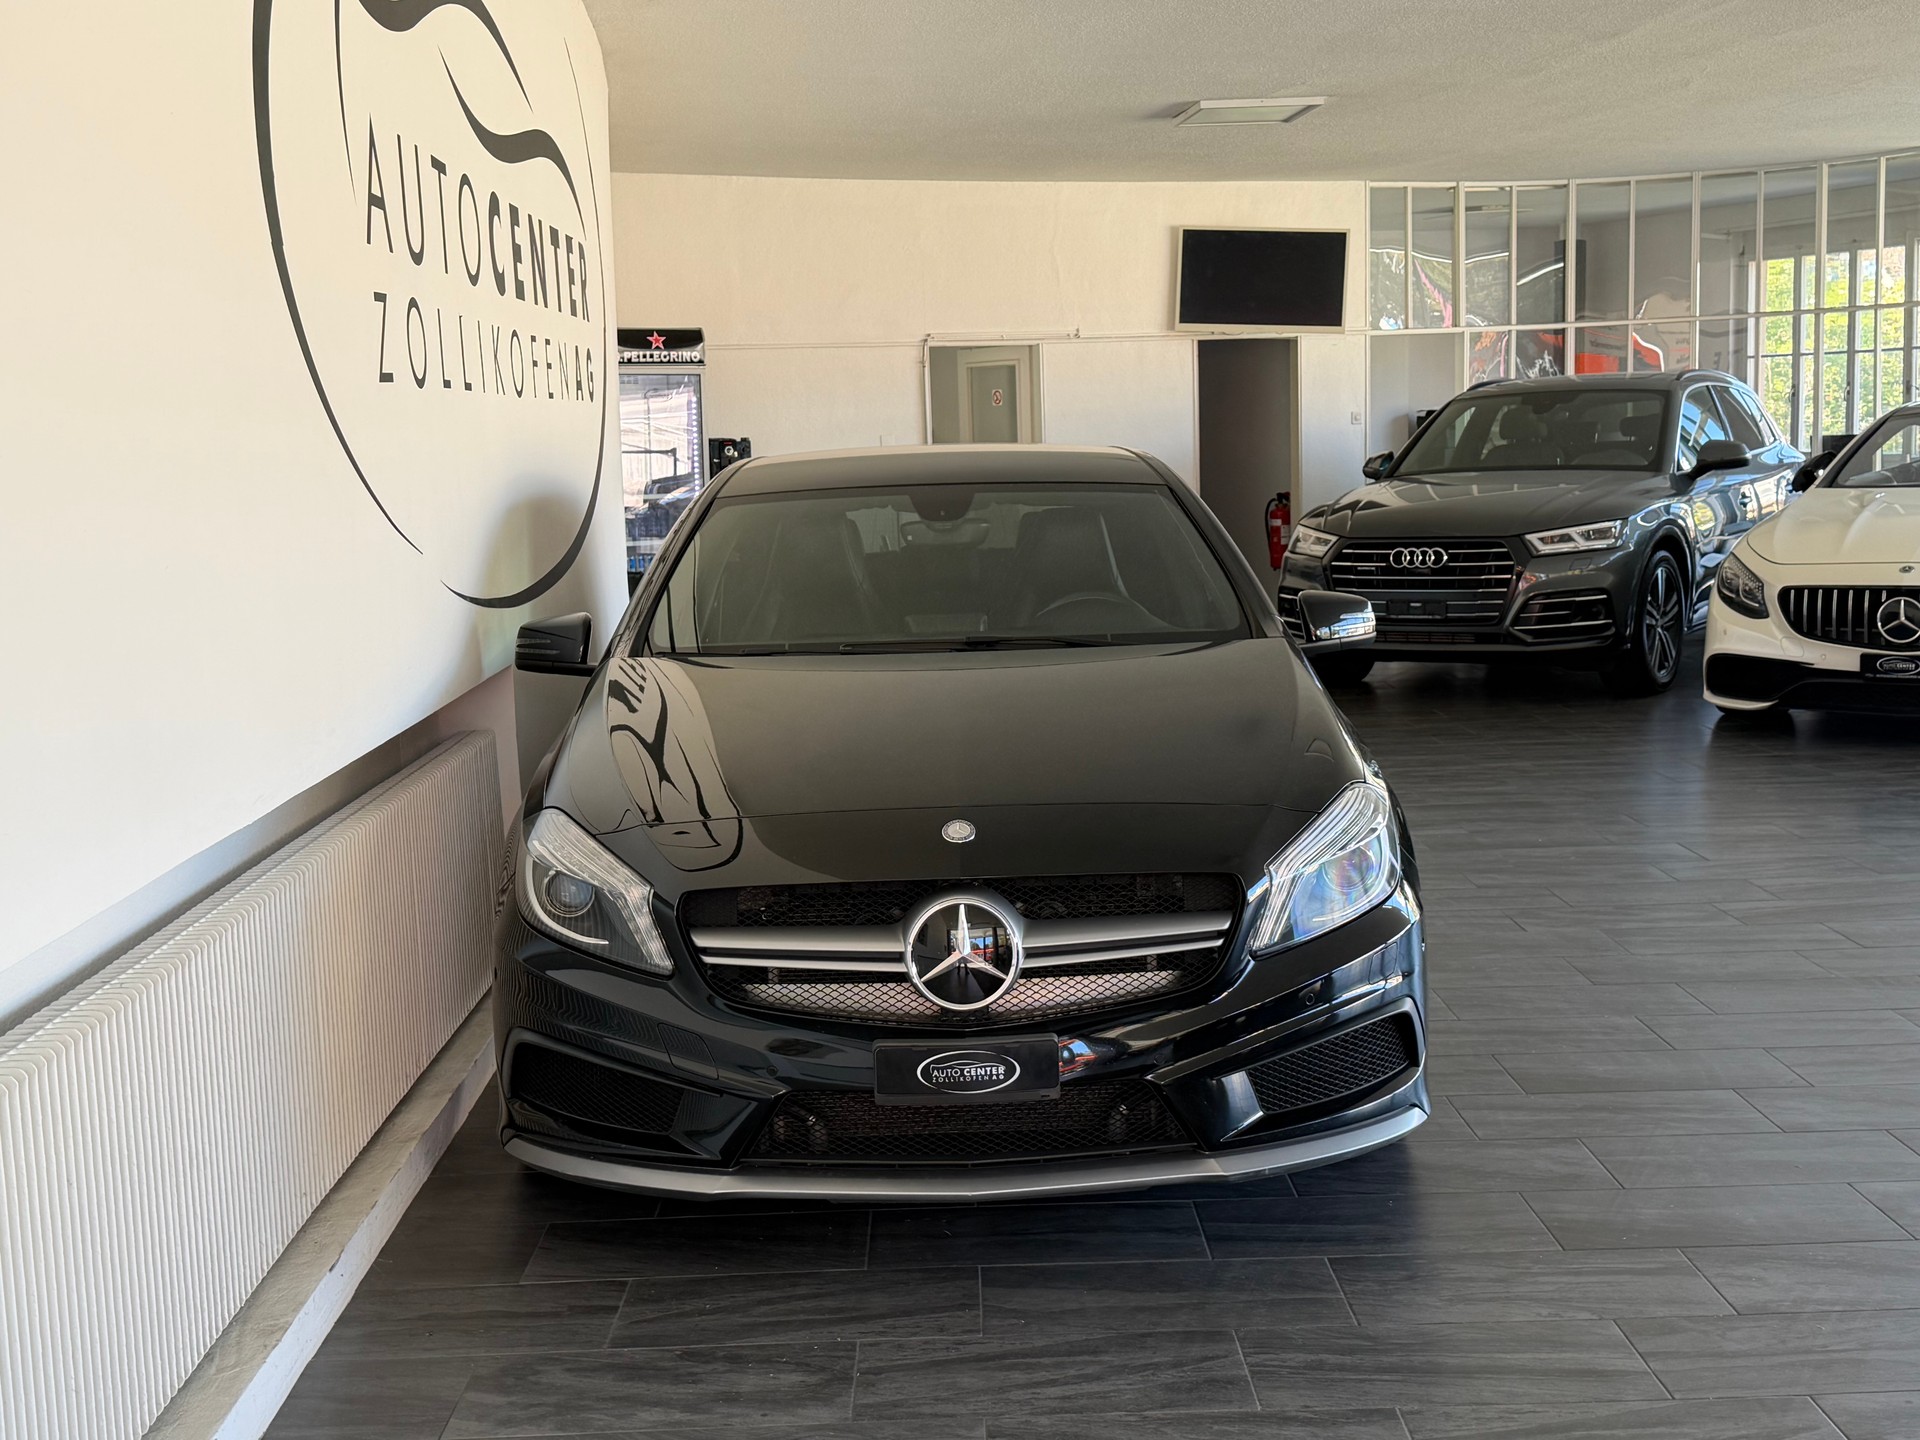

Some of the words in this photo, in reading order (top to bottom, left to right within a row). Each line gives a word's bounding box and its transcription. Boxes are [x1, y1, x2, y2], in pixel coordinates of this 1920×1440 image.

[617, 350, 701, 363] .PELLEGRINO
[932, 1068, 961, 1077] AUTO
[963, 1067, 1005, 1076] CENTER
